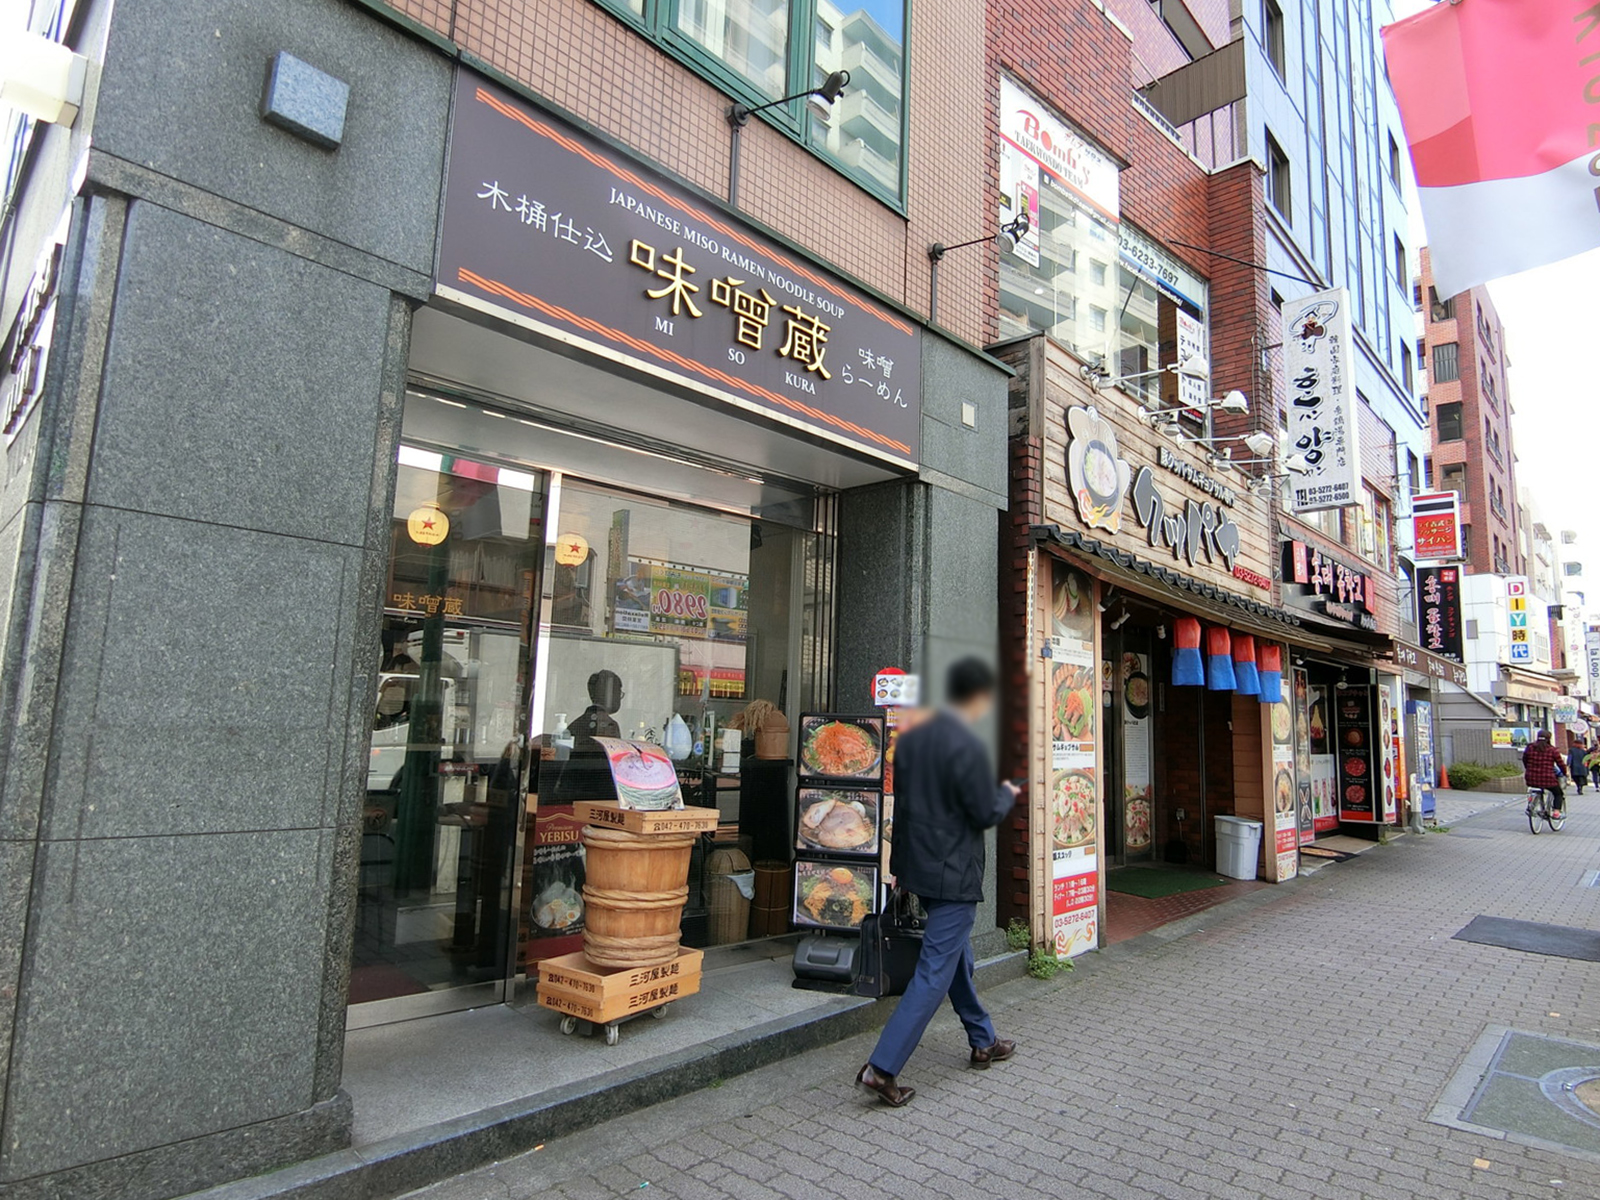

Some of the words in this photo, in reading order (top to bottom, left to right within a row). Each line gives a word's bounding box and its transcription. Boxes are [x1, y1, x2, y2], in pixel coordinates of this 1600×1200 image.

[477, 181, 613, 264] 木桶仕込
[609, 187, 681, 236] JAPANESE
[683, 226, 719, 255] MISO
[721, 246, 766, 280] RAMEN
[767, 270, 815, 305] NOODLE
[816, 296, 846, 320] SOUP
[630, 239, 832, 380] 味噌蔵
[655, 316, 675, 338] MI
[727, 347, 746, 366] SO
[858, 347, 894, 379] 味噌
[785, 371, 817, 396] KURA
[841, 363, 908, 408] らーめん
[393, 592, 464, 616] 味噌蔵
[1508, 582, 1529, 658] DIY時代
[1590, 647, 1600, 656] la
[1590, 657, 1600, 678] Loop
[589, 808, 626, 826] 三河屋製麺
[539, 830, 580, 843] YEBISU
[629, 962, 680, 988] 三河屋製麺
[628, 982, 679, 1010] 三河屋製麺
